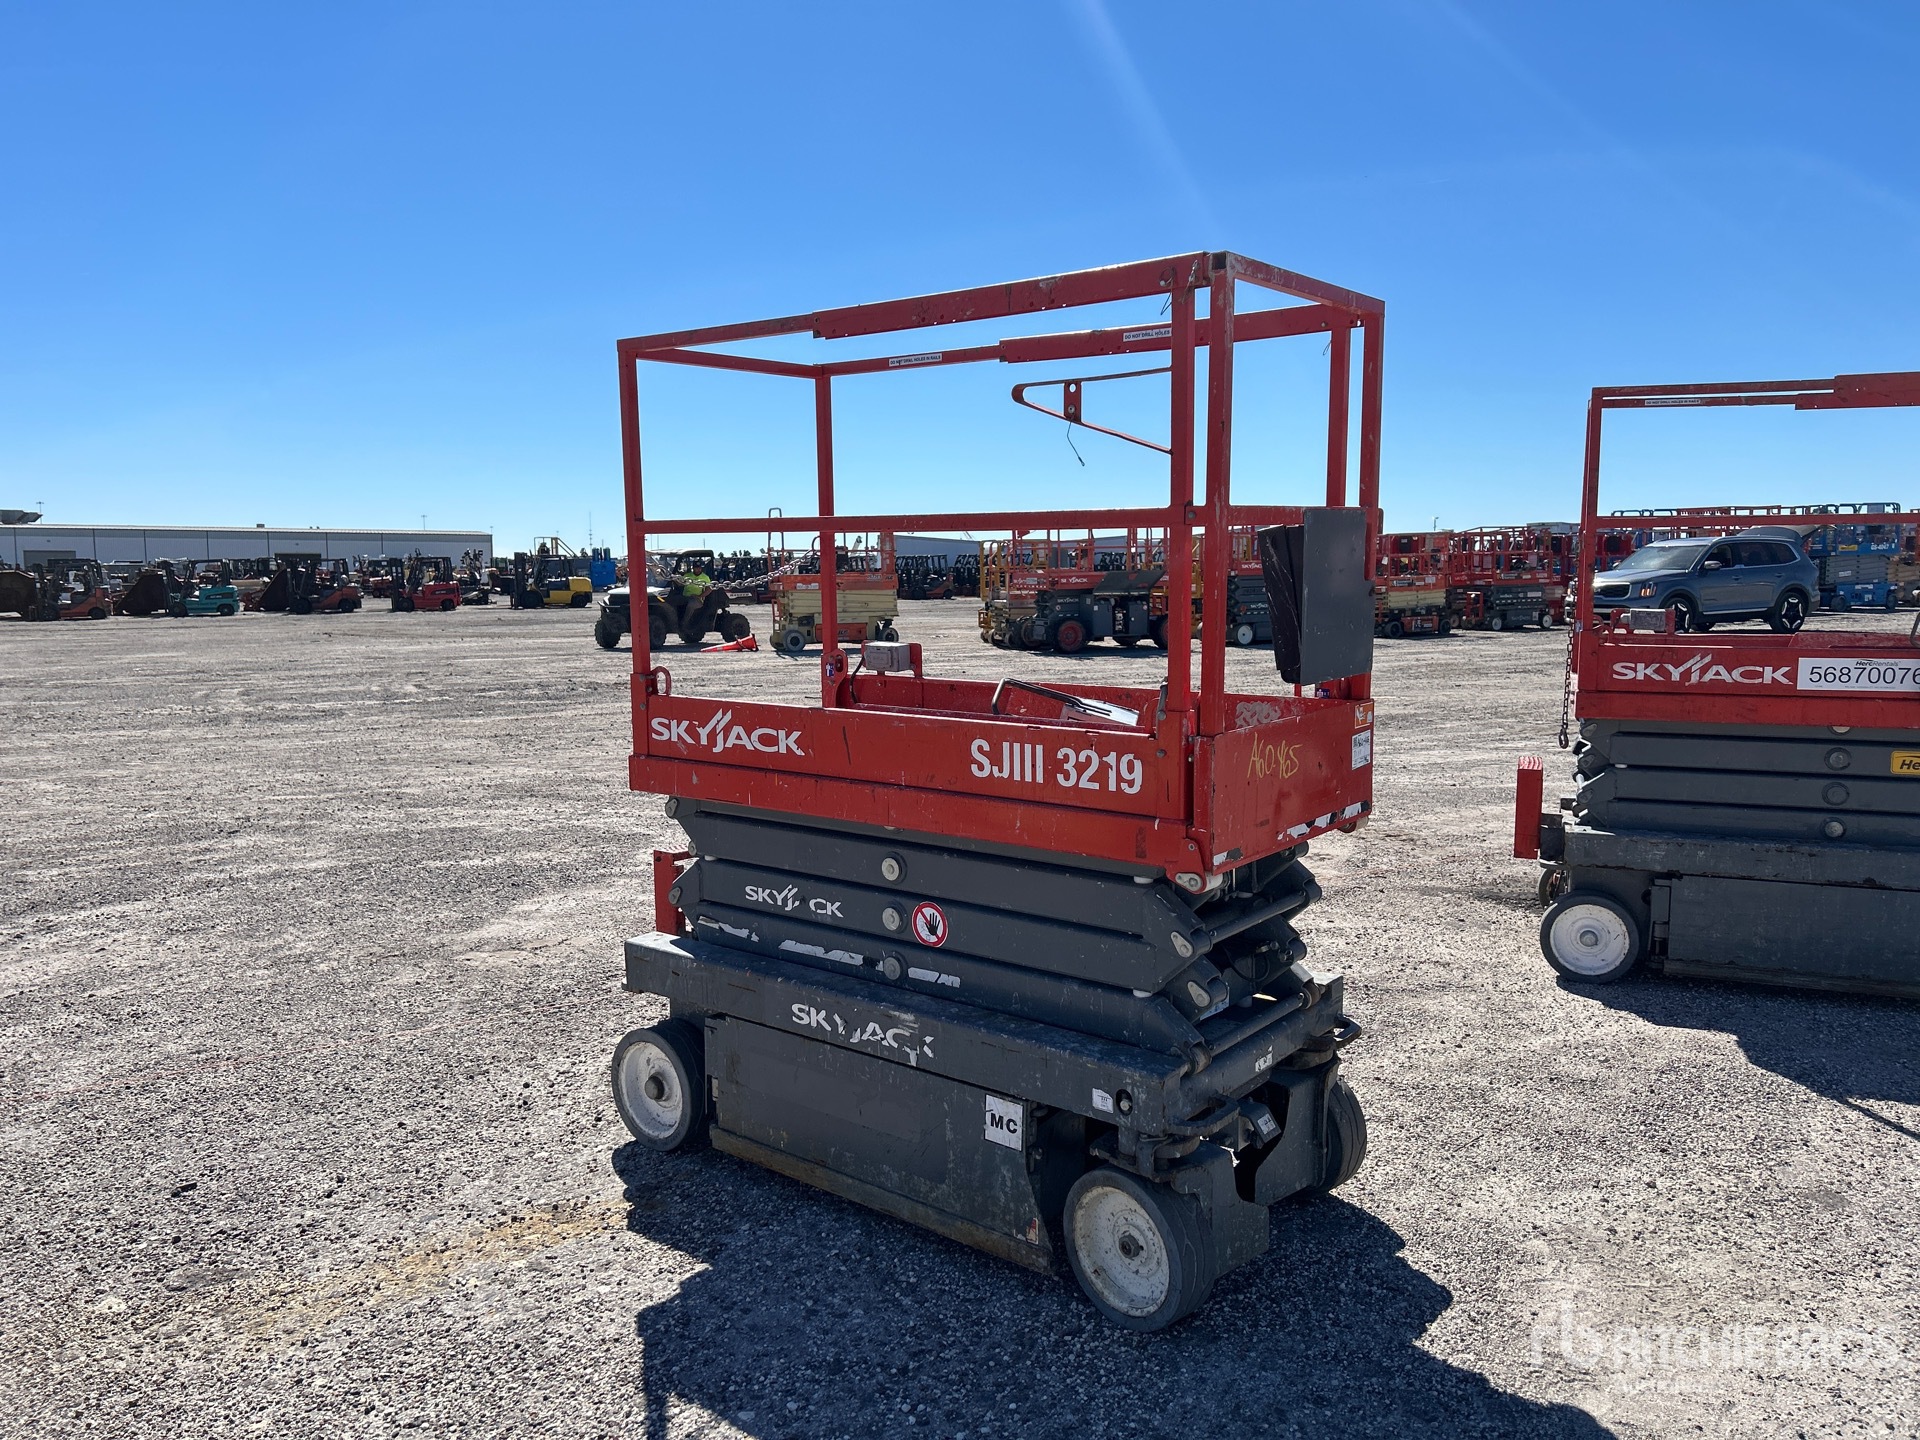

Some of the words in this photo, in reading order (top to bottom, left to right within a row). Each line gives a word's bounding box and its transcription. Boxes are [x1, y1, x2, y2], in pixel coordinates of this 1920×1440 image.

[1612, 653, 1794, 687] SKYJACK
[1809, 666, 1920, 685] 56870076
[651, 708, 805, 756] SKYJACK
[970, 738, 1044, 784] SJIII
[1056, 747, 1143, 794] 3219
[745, 884, 844, 918] SKYJCK
[990, 1112, 1018, 1134] MC
